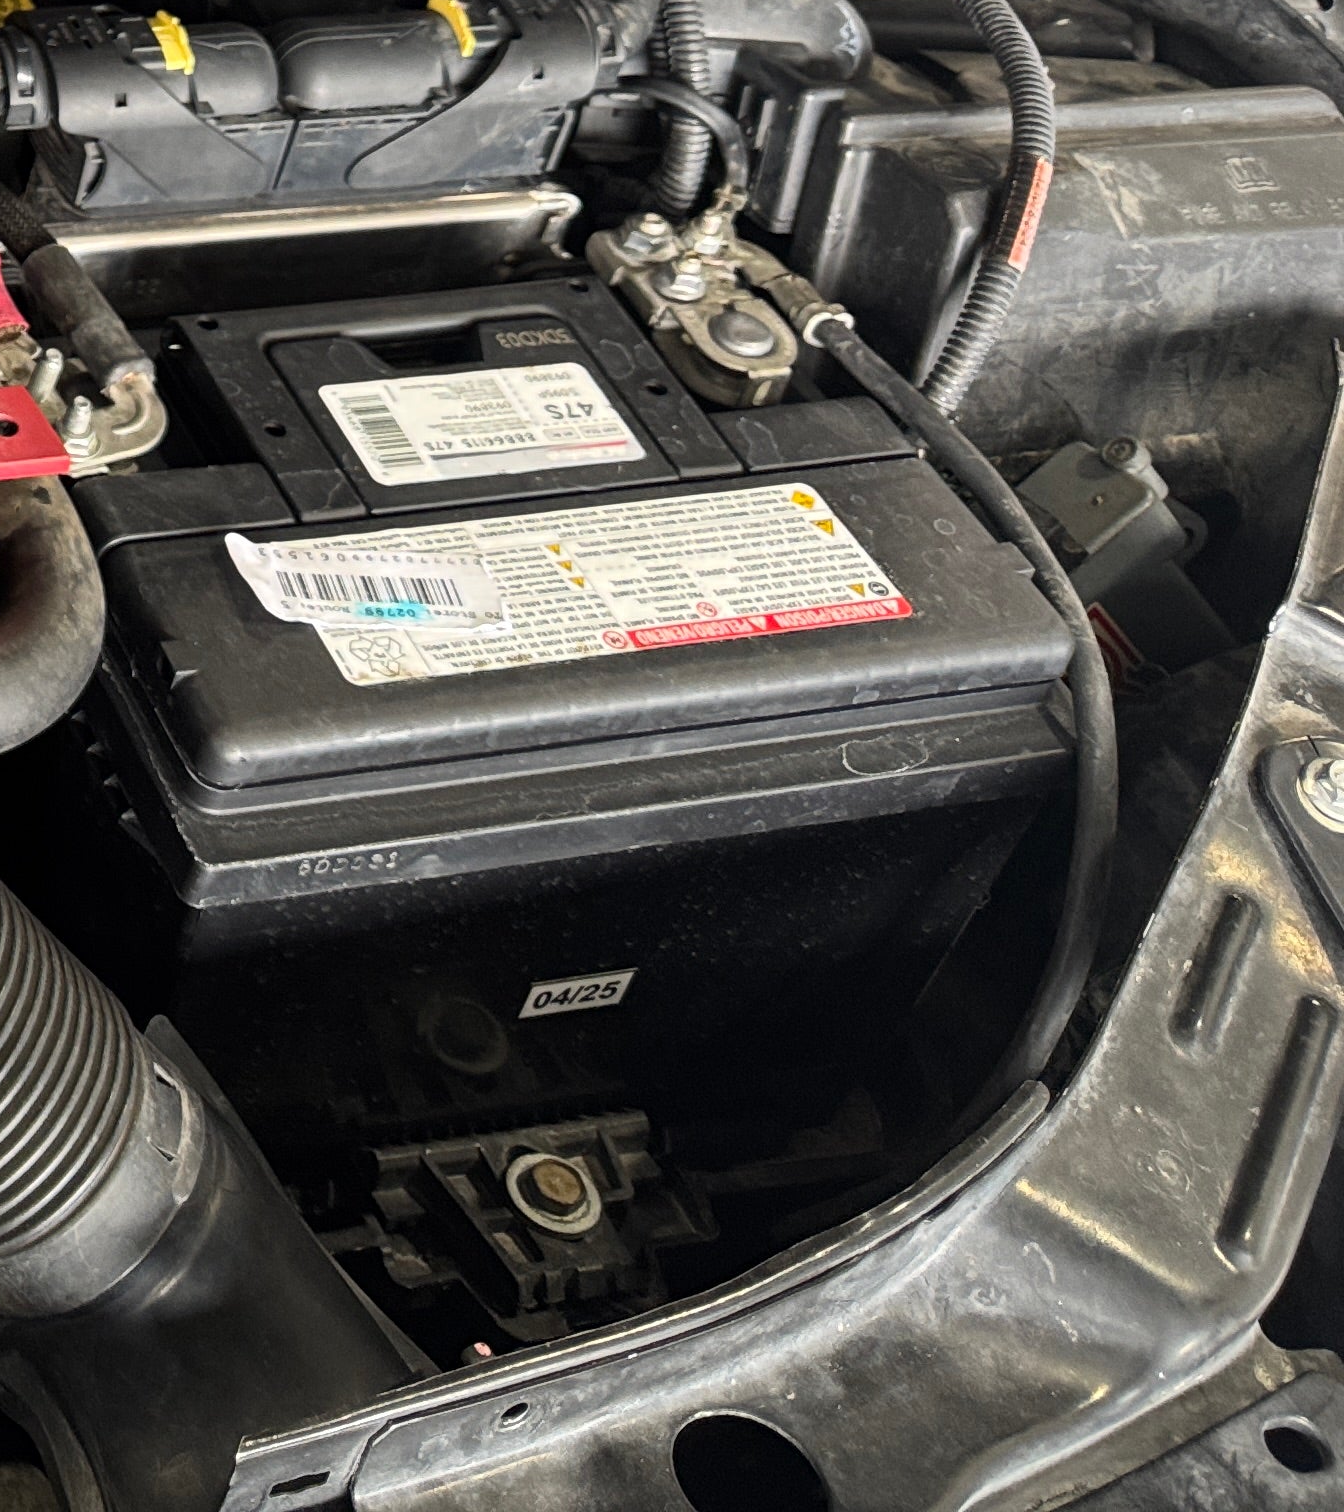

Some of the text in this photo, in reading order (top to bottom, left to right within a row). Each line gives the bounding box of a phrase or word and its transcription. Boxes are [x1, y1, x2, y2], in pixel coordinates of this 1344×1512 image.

[544, 402, 593, 419] 47S
[484, 611, 503, 620] To
[533, 980, 621, 1009] 04/25
